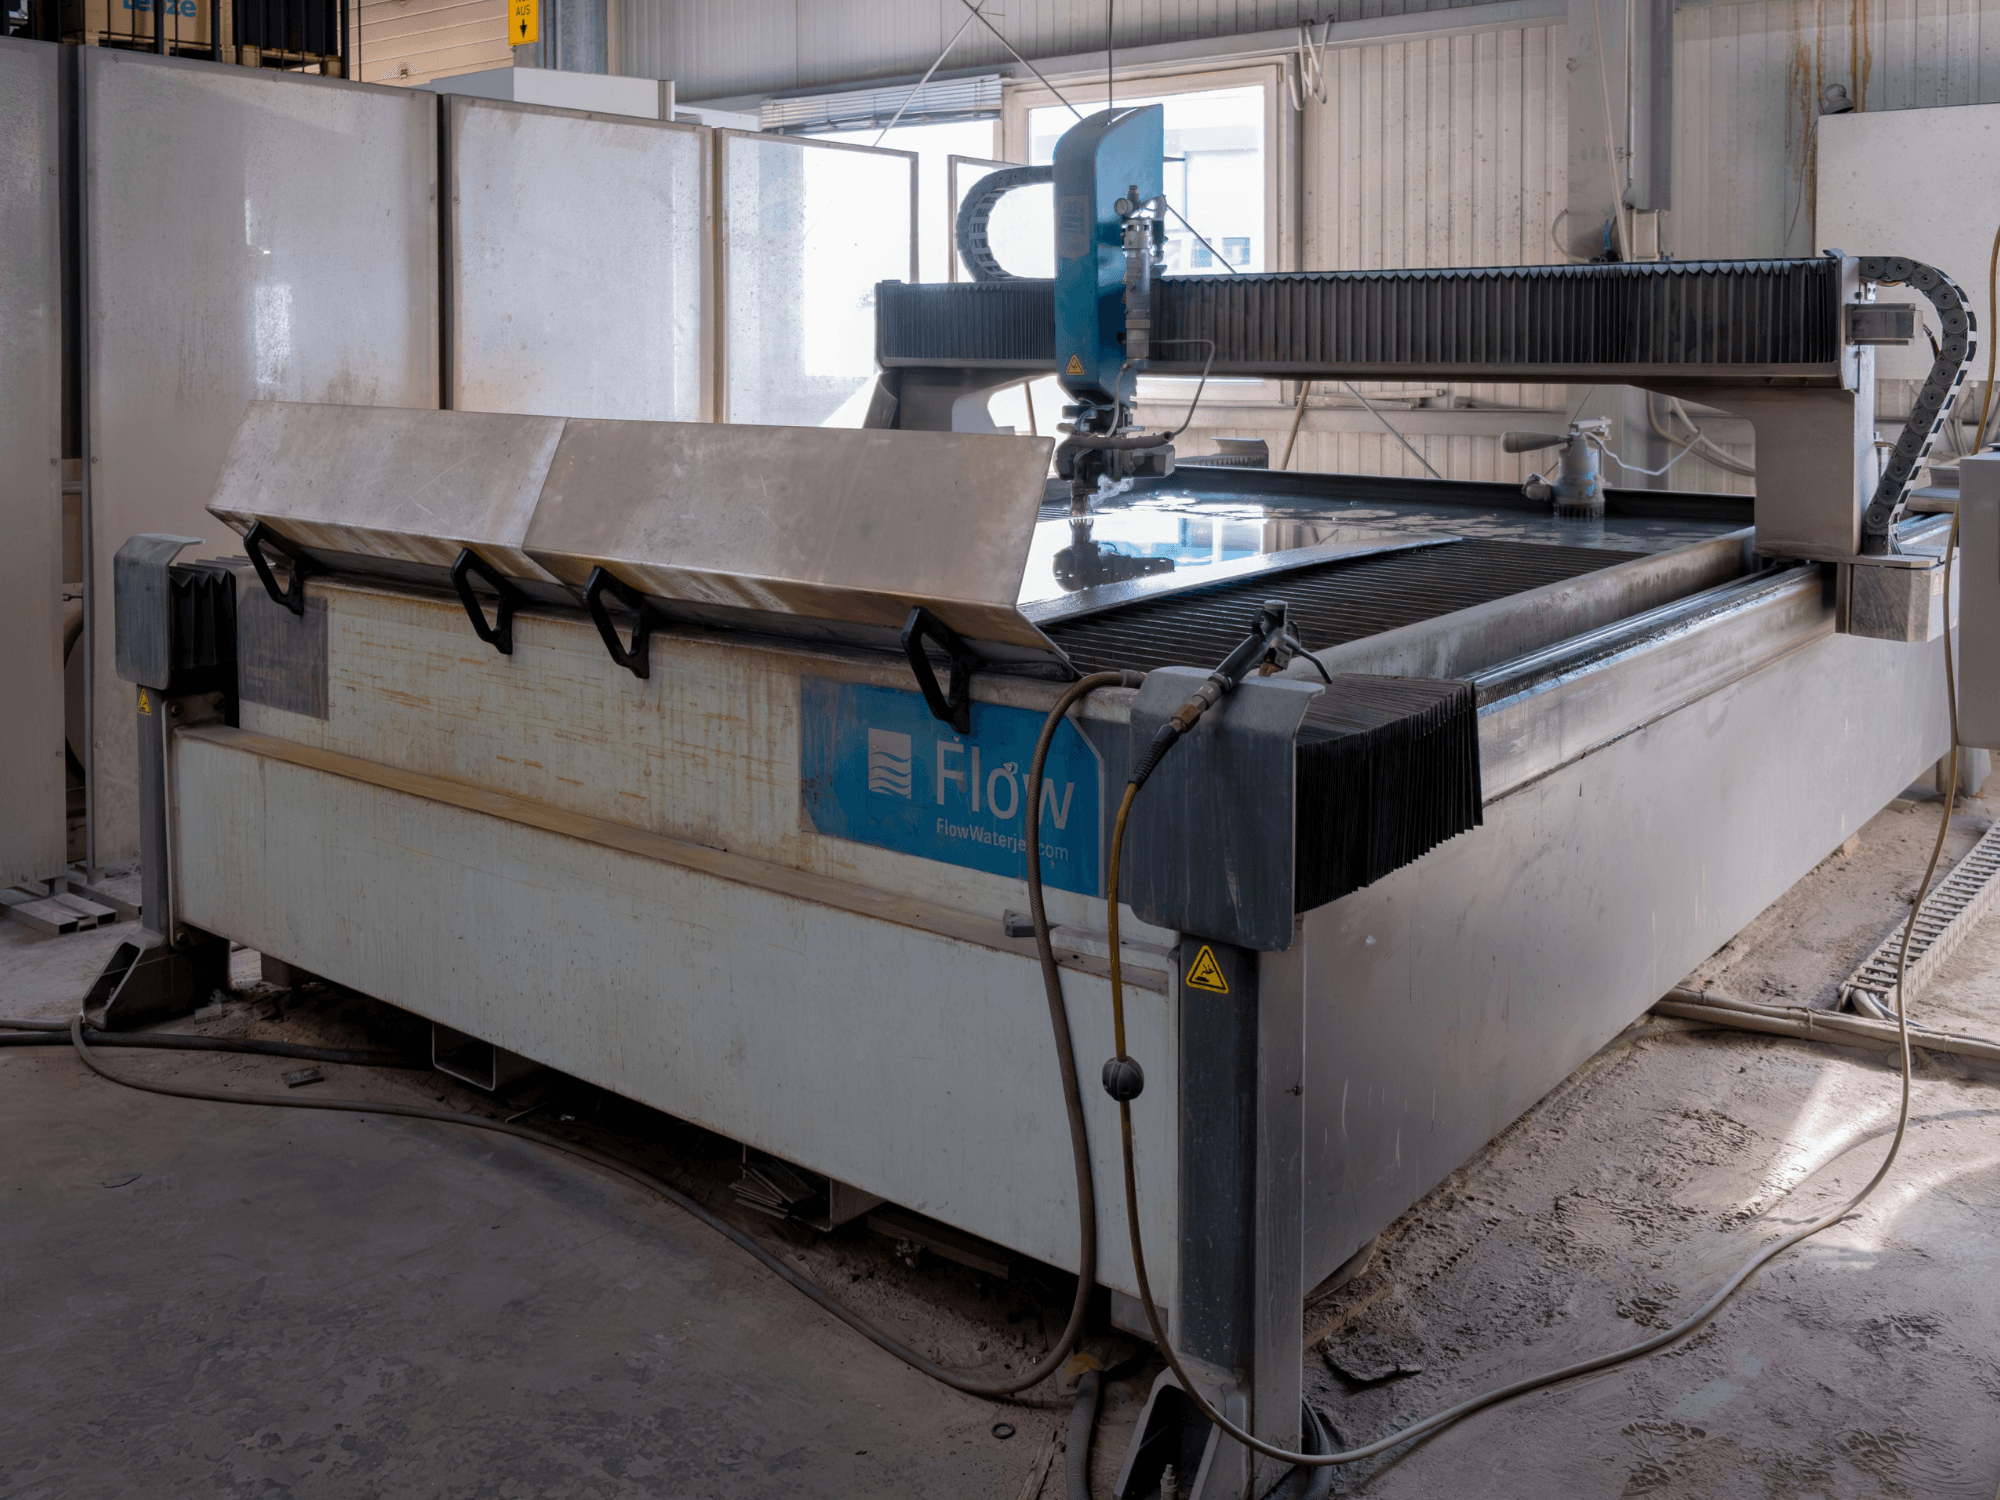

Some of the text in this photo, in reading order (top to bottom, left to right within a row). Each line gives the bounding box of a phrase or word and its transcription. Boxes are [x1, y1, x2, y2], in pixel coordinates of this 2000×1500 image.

[515, 4, 531, 17] AUS
[936, 740, 1075, 830] Flow
[936, 817, 1069, 862] FlowWaterjecom
